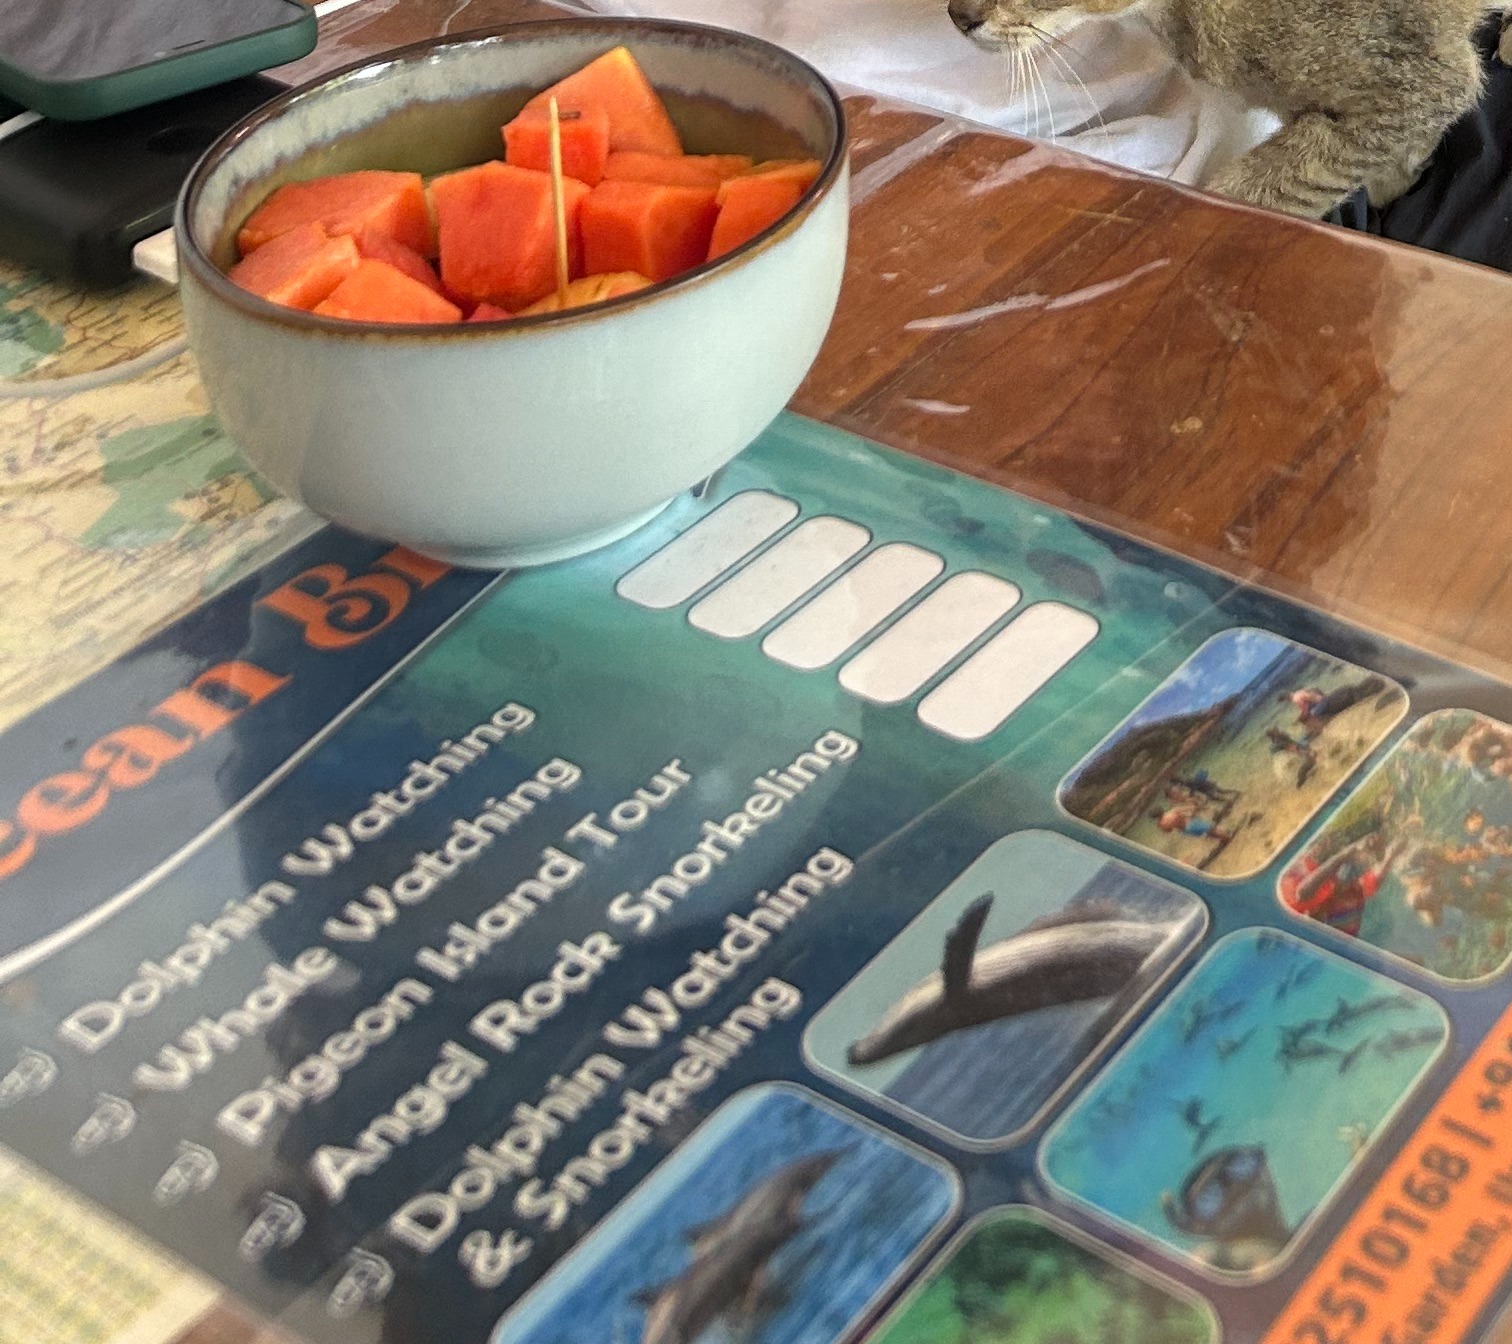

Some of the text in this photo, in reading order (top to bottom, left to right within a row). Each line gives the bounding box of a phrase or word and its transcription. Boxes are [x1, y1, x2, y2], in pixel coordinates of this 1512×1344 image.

[58, 702, 536, 1054] Dolphin Watching
[133, 756, 582, 1092] Whale Watching
[215, 757, 693, 1146] Pigeon Island Tour
[310, 729, 860, 1202] Angel Rock Snorkeling
[391, 845, 856, 1254] Dolphin Watching
[457, 976, 802, 1287] & Snorkeling
